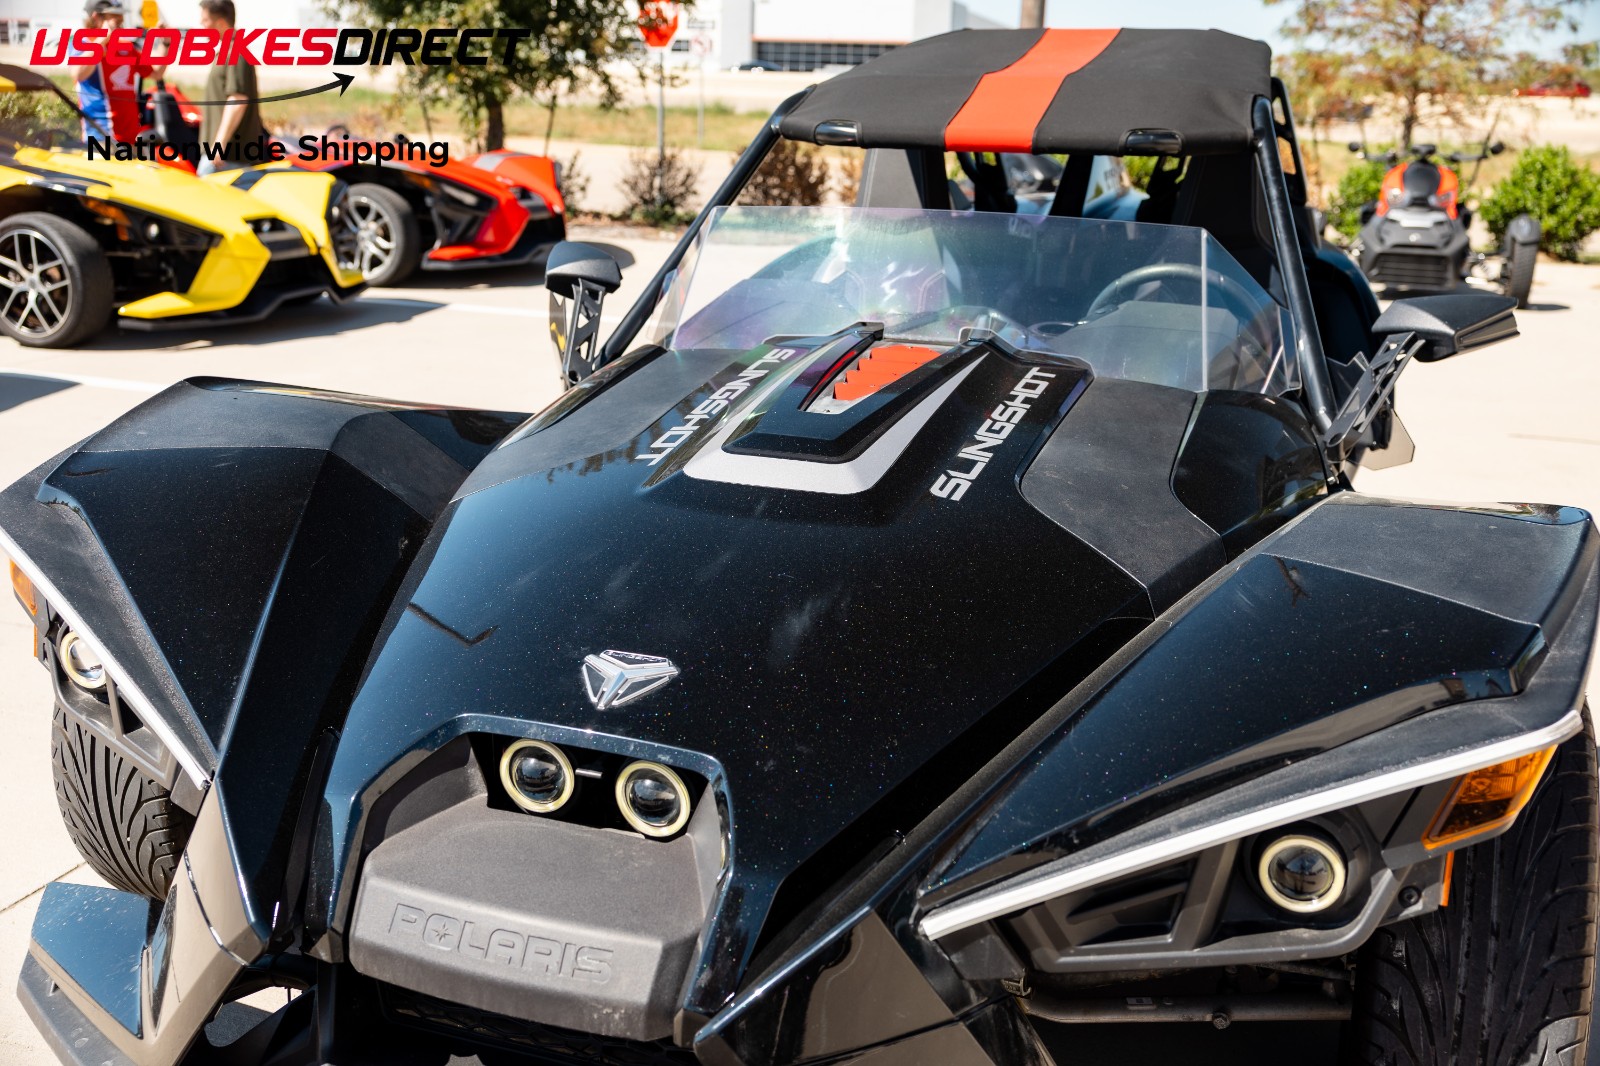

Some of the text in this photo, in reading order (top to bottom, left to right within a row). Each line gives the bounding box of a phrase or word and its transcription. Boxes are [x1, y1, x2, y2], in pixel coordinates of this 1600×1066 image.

[634, 348, 796, 467] SLINGSHOT
[929, 366, 1057, 502] SLINGSHOT
[388, 902, 614, 985] POLARIS
